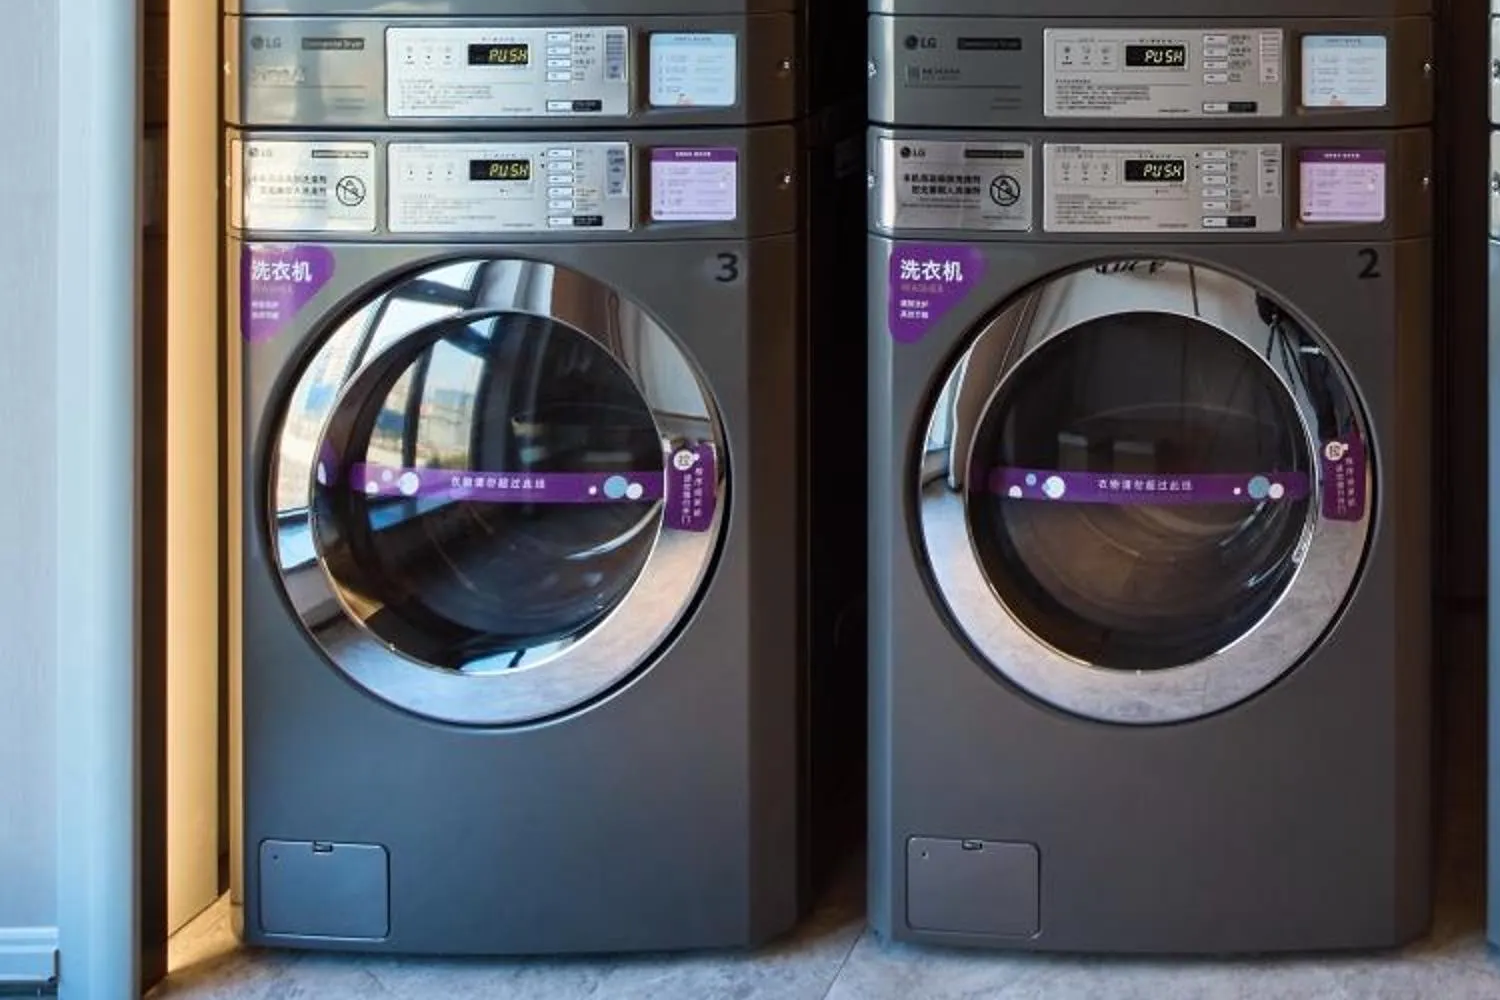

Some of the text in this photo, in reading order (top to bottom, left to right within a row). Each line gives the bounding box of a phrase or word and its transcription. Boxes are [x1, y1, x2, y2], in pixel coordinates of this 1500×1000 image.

[266, 37, 281, 49] LG
[920, 37, 938, 49] LG
[489, 48, 528, 63] PUSH
[1144, 49, 1183, 64] PUSH
[488, 164, 527, 178] PUSH
[1143, 165, 1182, 178] PUSH
[251, 259, 313, 283] 洗衣机
[715, 252, 739, 282] 3
[900, 258, 964, 283] 洗衣机
[1357, 248, 1381, 279] 2
